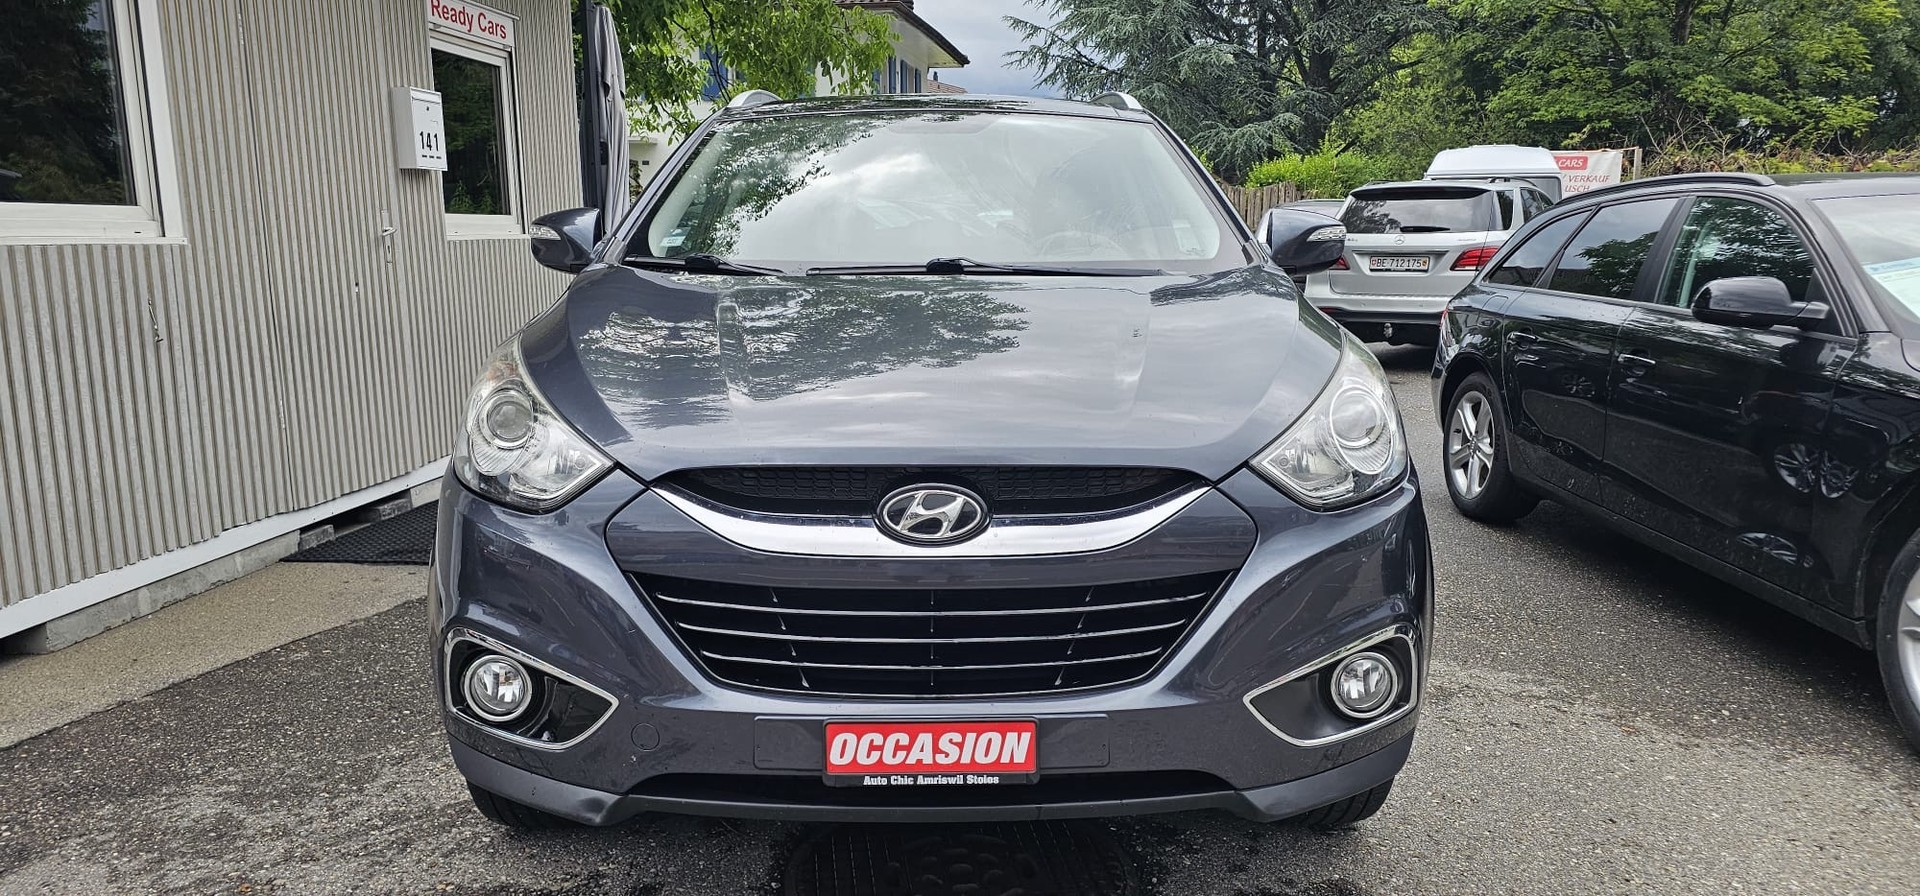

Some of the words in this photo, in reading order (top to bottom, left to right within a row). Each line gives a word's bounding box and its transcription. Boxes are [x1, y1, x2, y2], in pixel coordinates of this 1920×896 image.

[431, 0, 474, 33] Ready
[478, 12, 507, 39] Cars
[420, 131, 439, 152] 141
[1558, 159, 1584, 168] CARS
[1568, 174, 1611, 183] VERKAUF
[829, 731, 1032, 766] OCCASION
[863, 775, 888, 786] Auto
[890, 775, 914, 785] Chic
[917, 774, 964, 785] Amriswil
